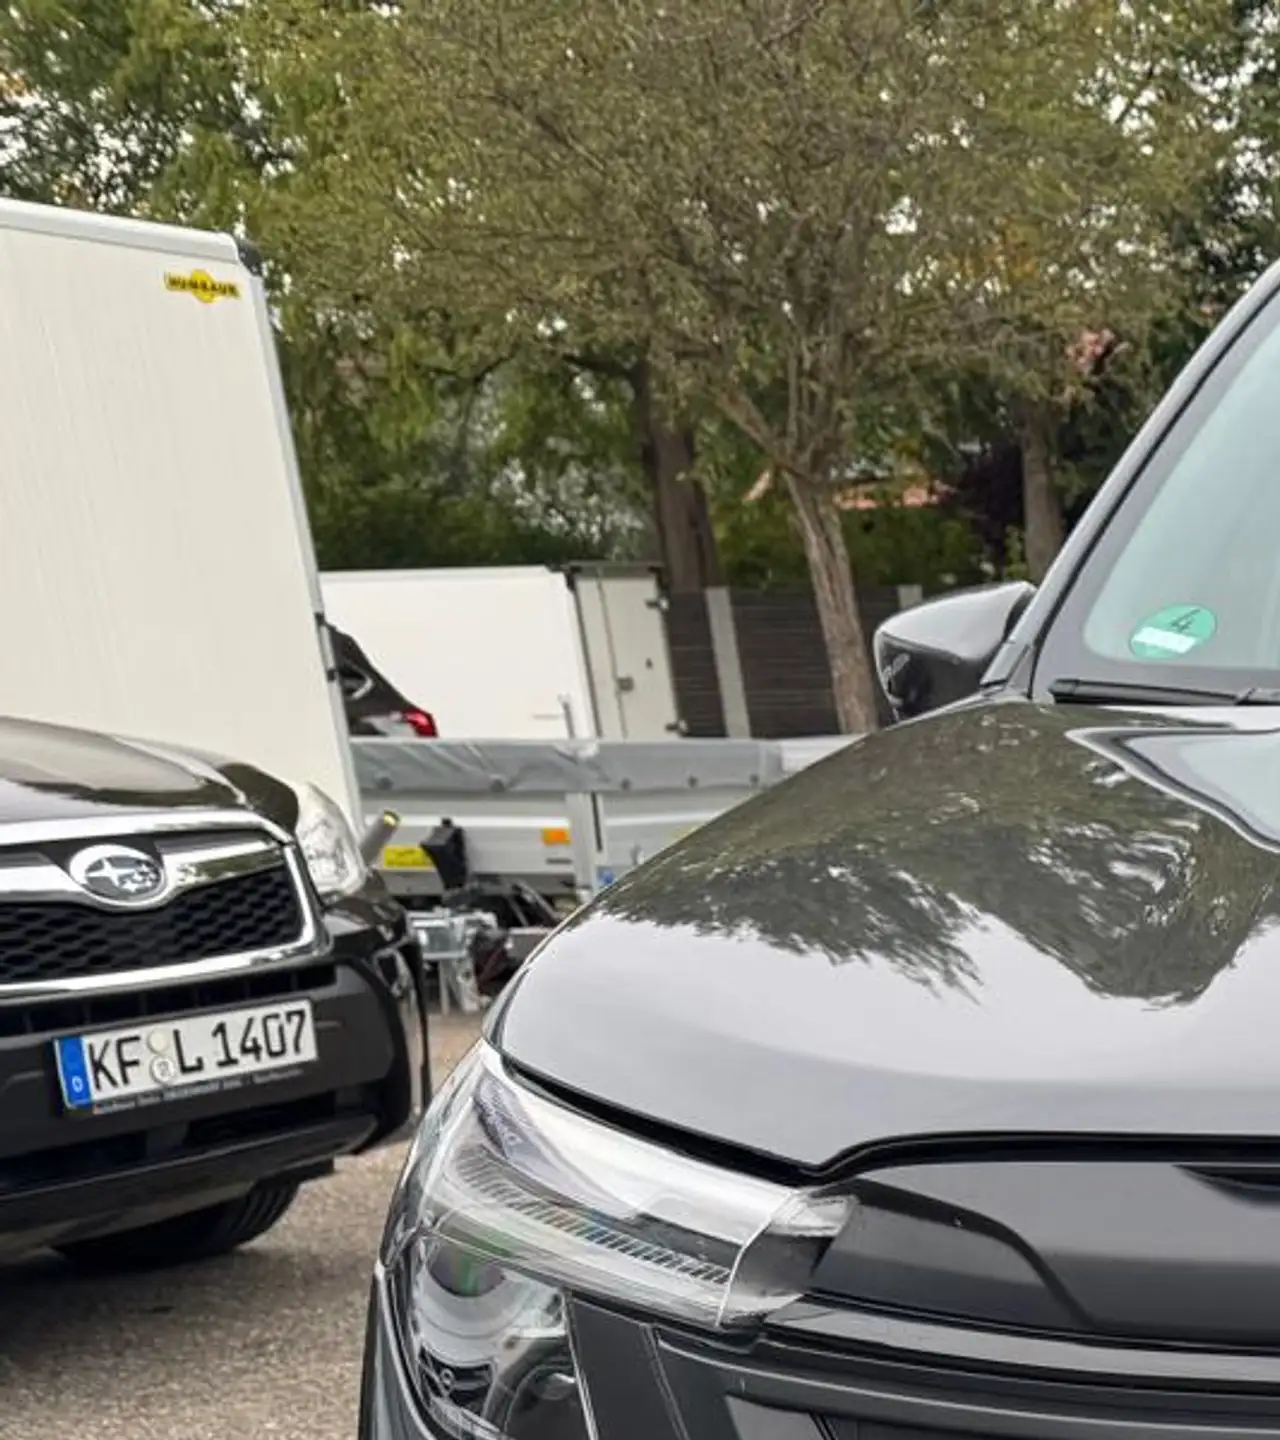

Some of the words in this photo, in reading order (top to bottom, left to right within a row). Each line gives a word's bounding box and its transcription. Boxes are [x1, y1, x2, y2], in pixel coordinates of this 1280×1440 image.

[1170, 608, 1200, 632] 4
[89, 1036, 141, 1090] KF
[174, 1029, 203, 1075] L
[212, 1010, 305, 1067] 1407
